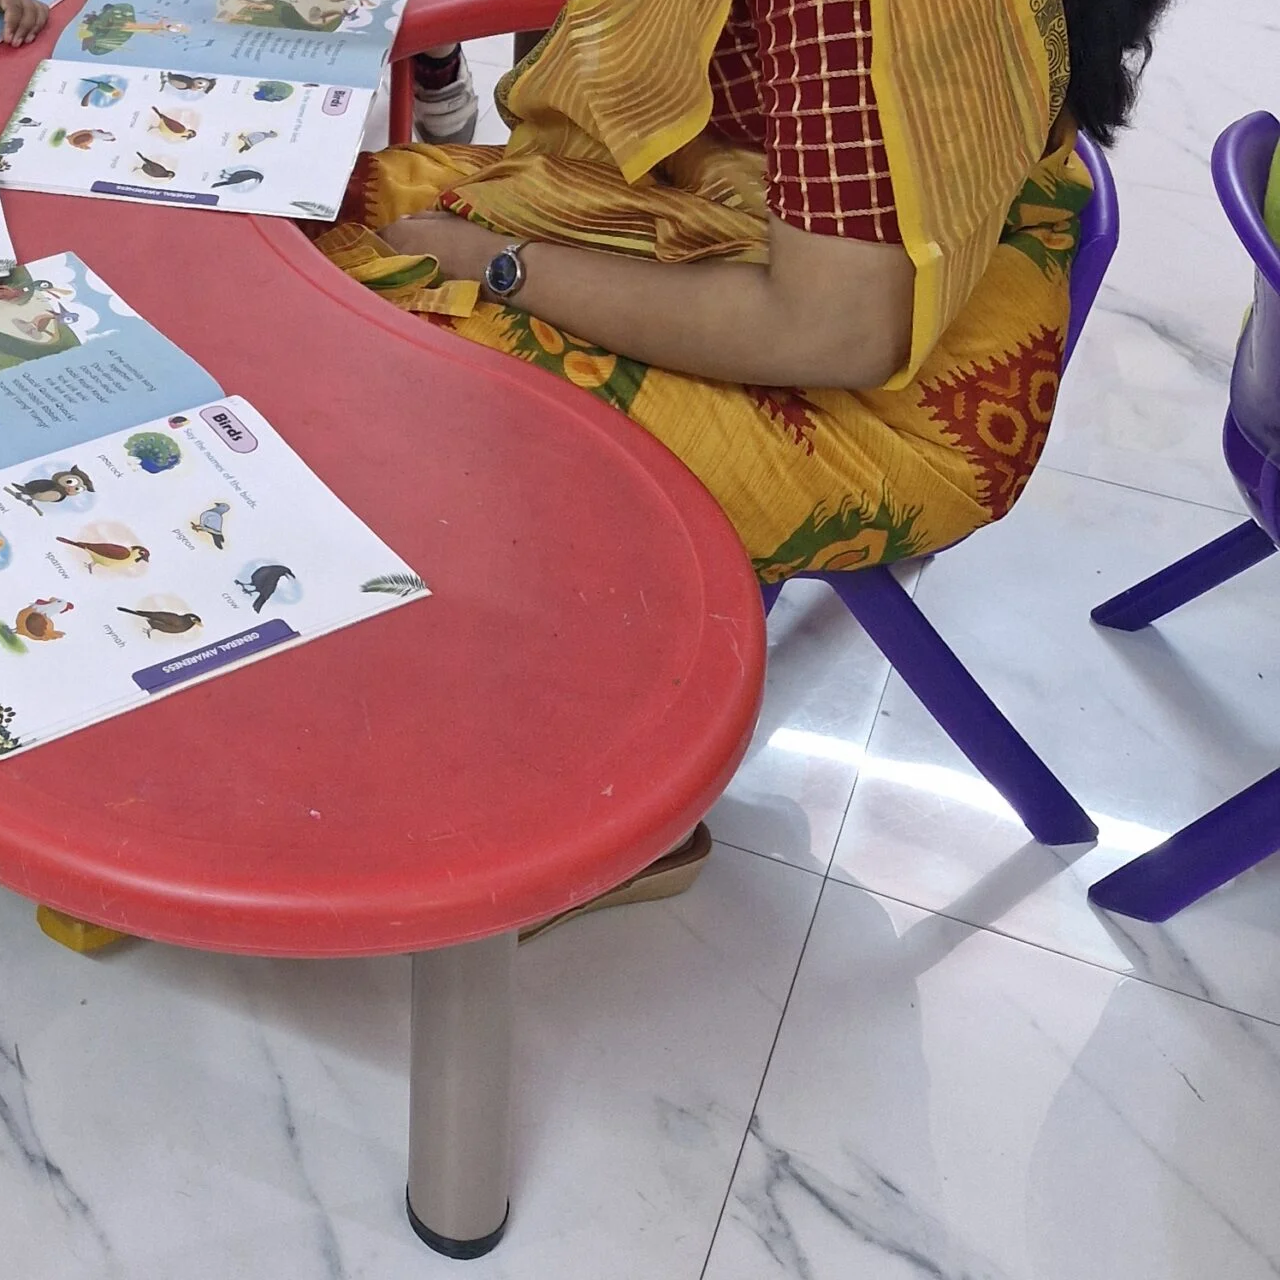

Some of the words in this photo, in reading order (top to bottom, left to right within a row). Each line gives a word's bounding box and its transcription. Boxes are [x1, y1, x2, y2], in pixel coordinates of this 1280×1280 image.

[184, 427, 197, 444] Say
[212, 413, 244, 442] Birds
[195, 439, 206, 452] the
[98, 454, 124, 479] peacock
[204, 451, 223, 472] names
[223, 471, 234, 481] of
[228, 478, 242, 492] the
[240, 491, 257, 510] birds.
[172, 528, 196, 551] pigeon
[45, 552, 70, 579] sparrow
[221, 592, 240, 610] crow
[103, 623, 126, 648] mynah
[219, 632, 260, 653] GENERAL
[162, 646, 219, 674] AWARENESS
